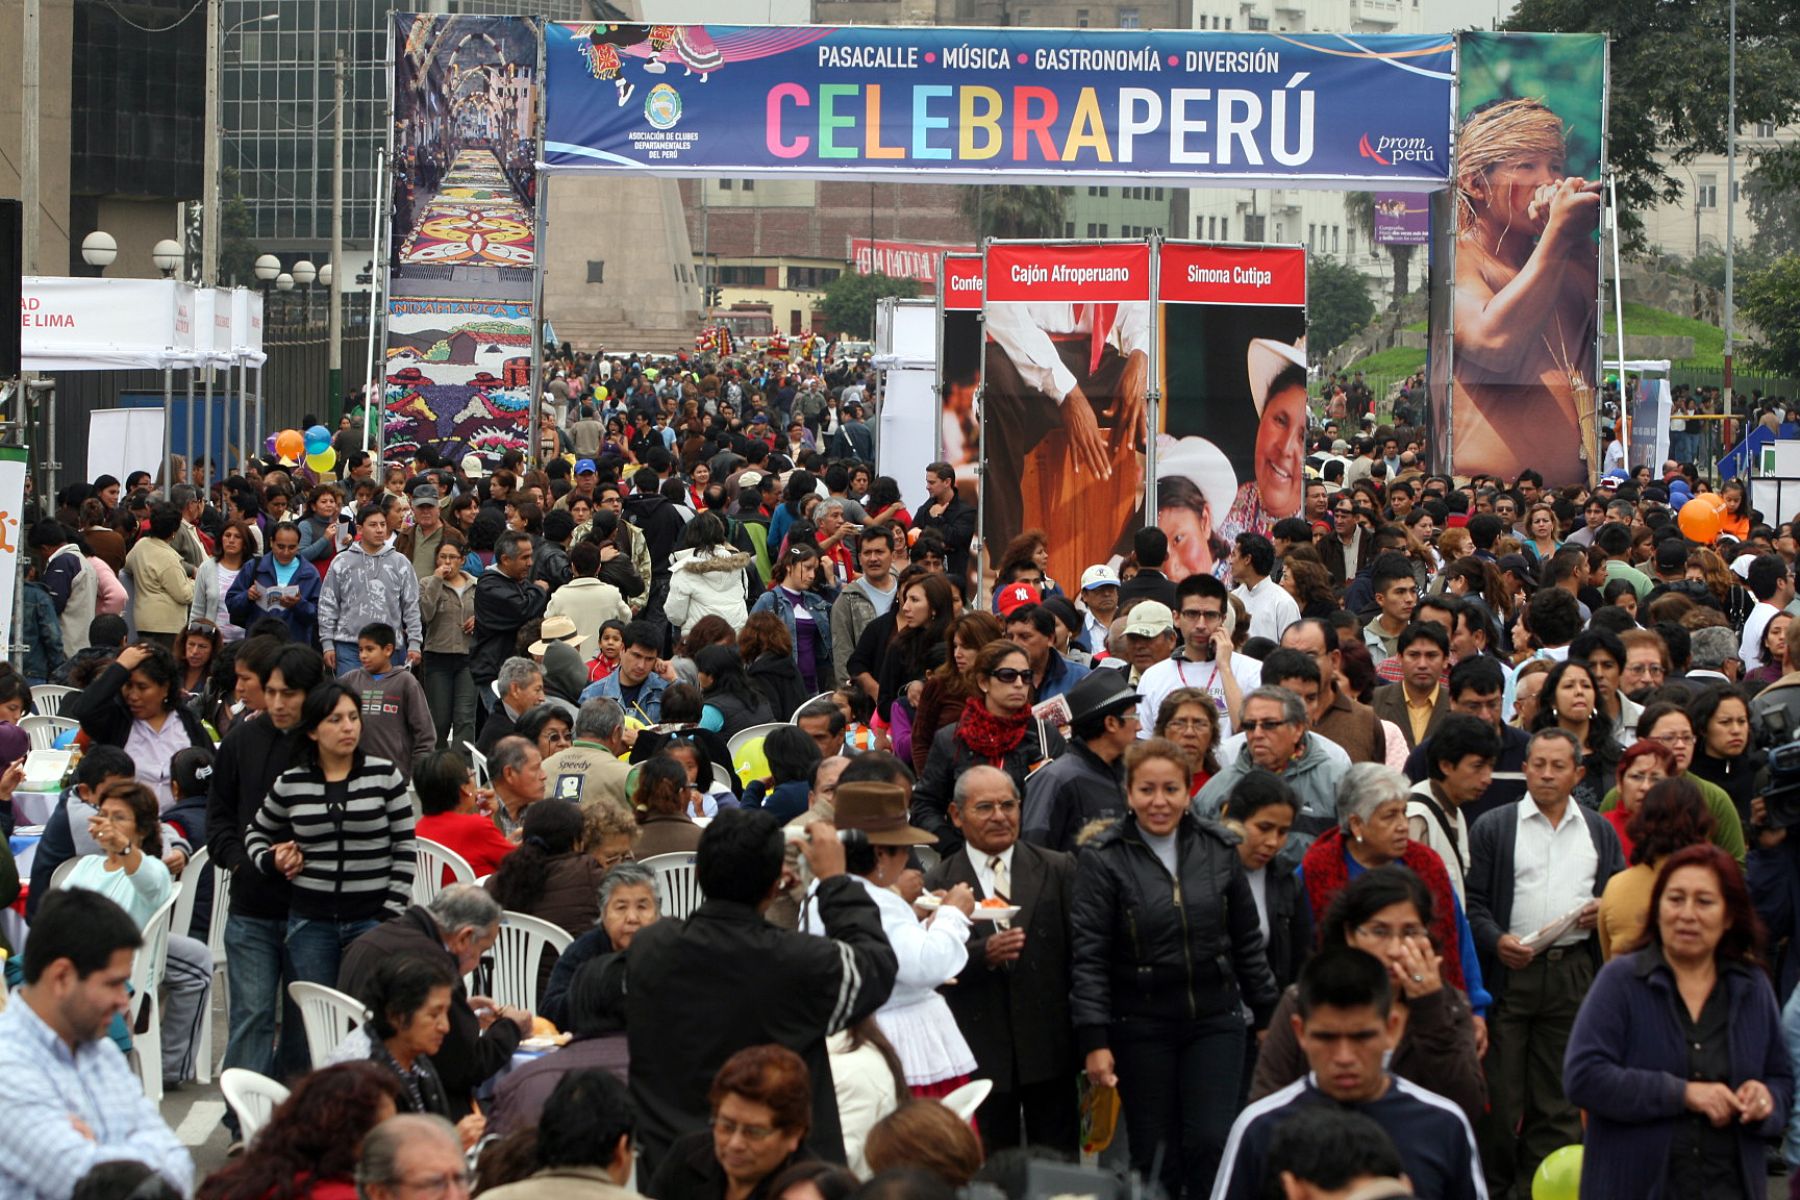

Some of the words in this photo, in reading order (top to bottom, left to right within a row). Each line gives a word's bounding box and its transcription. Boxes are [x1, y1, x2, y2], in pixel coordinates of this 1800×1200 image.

[818, 46, 918, 68] PASACALLE
[943, 43, 1010, 69] MÚSICA
[1035, 46, 1161, 71] GASTRONOMÍA
[1185, 48, 1279, 73] DIVERSIÓN
[766, 72, 1315, 167] CELEBRAPERÚ
[628, 131, 665, 140] ASOCIACIÓN
[666, 132, 674, 140] DE
[675, 132, 699, 141] CLUBES
[634, 141, 691, 149] DEPARTAMENTALES
[1376, 135, 1426, 153] prom
[649, 150, 660, 159] DEL
[662, 149, 678, 159] PERÚ
[1392, 145, 1434, 165] perú
[1011, 264, 1048, 286] Cajón
[1051, 265, 1129, 285] Afroperuano
[1187, 264, 1230, 283] Simona
[1233, 266, 1271, 288] Cutipa
[35, 314, 75, 327] LIMA
